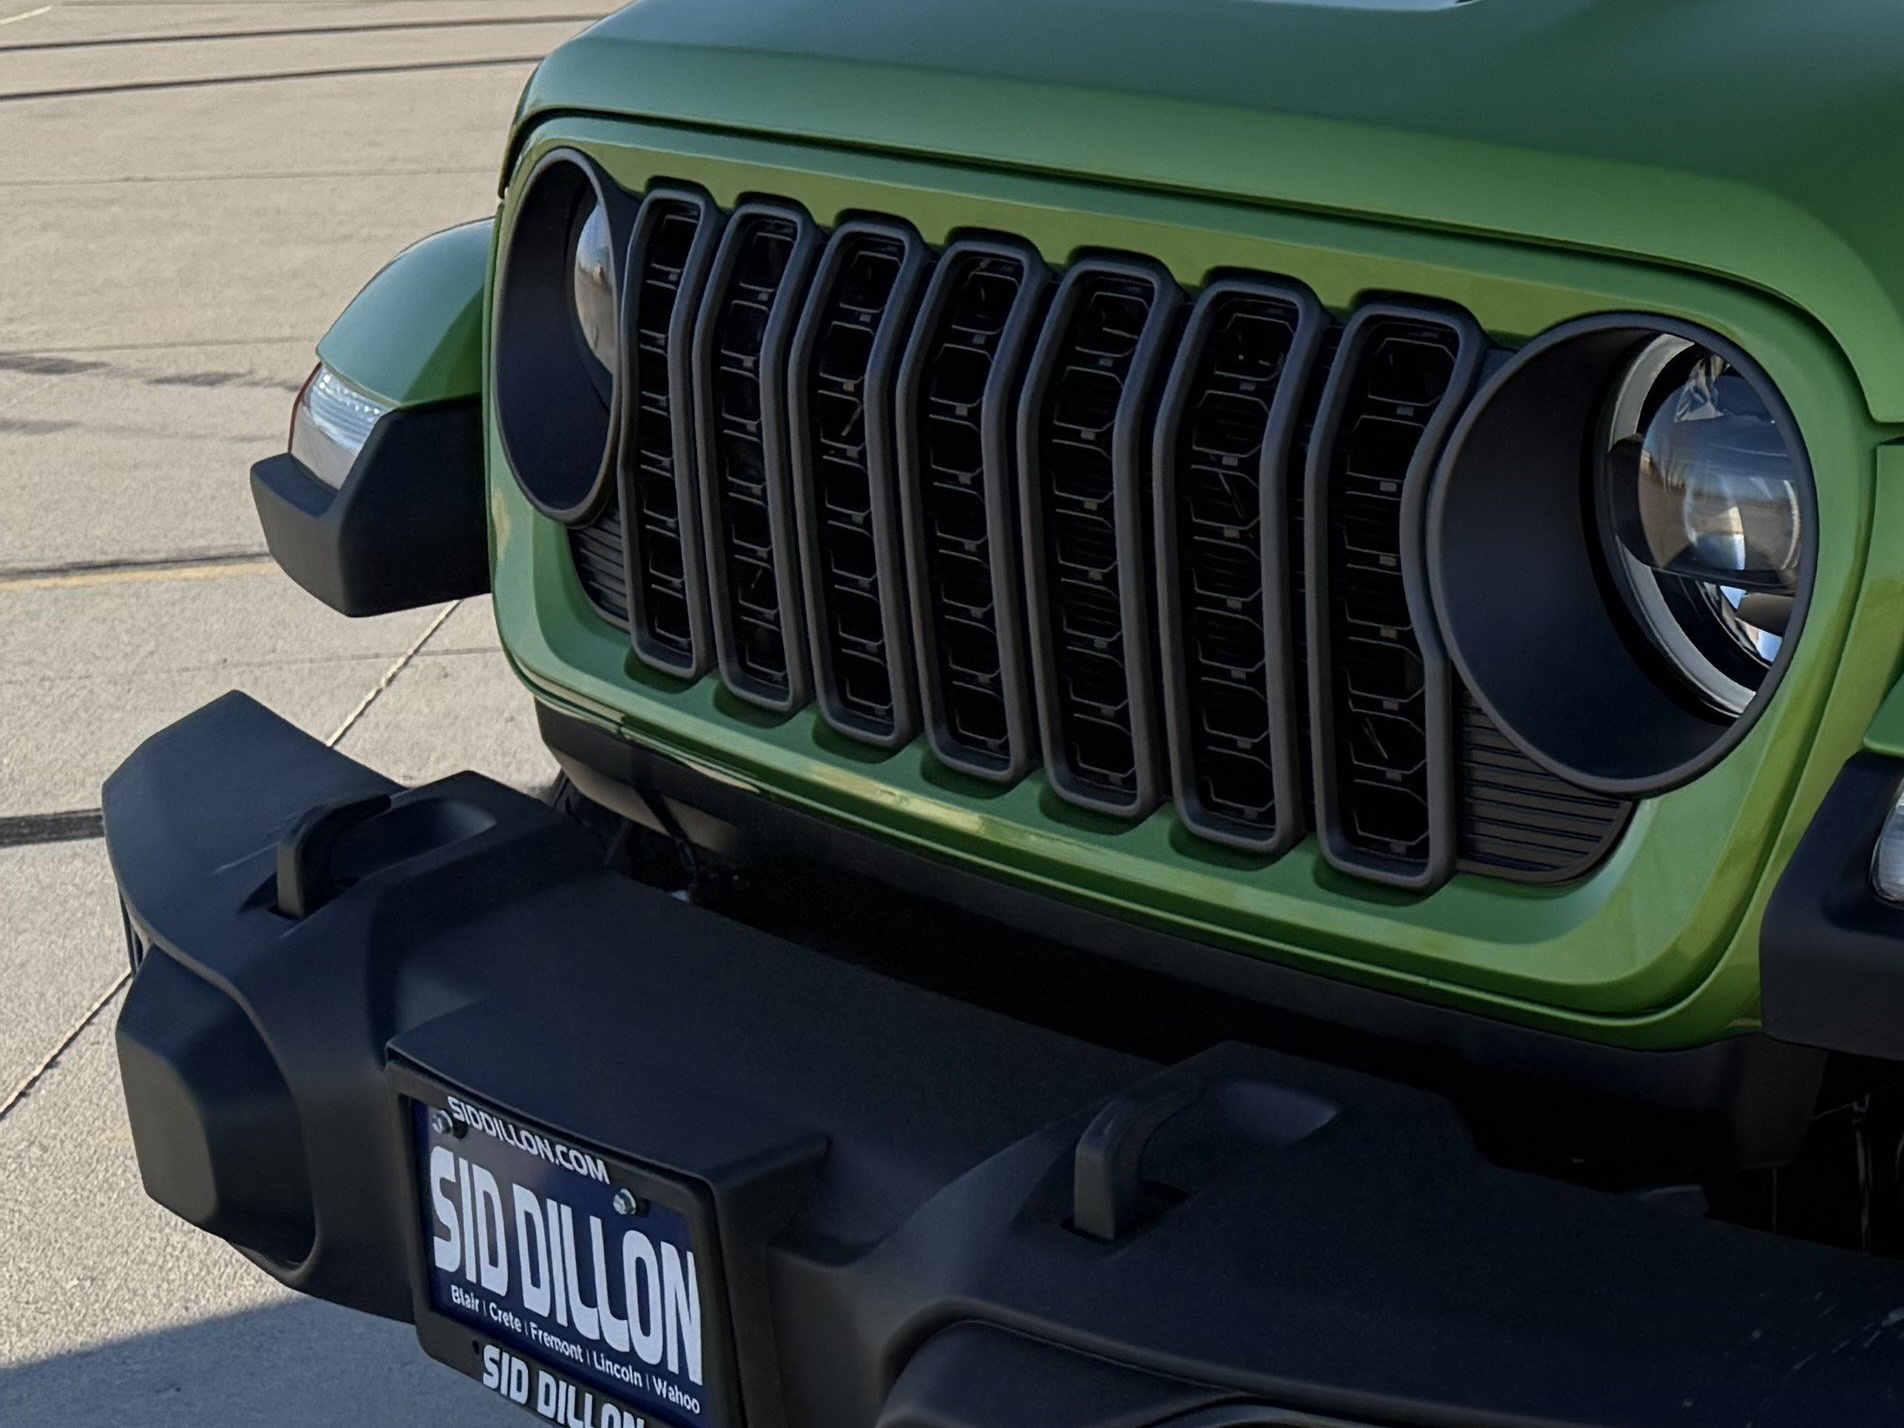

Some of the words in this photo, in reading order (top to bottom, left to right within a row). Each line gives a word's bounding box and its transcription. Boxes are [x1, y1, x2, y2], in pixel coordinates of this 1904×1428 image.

[447, 1095, 611, 1185] SIDDILLON.COM
[430, 1145, 509, 1298] SID
[512, 1182, 703, 1386] DILLON
[450, 1284, 480, 1314] Blair
[489, 1303, 522, 1334] Crete
[530, 1322, 584, 1363] Fremont
[593, 1350, 643, 1389] Lincoln
[653, 1377, 701, 1415] Wahoo
[481, 1344, 530, 1406] SID
